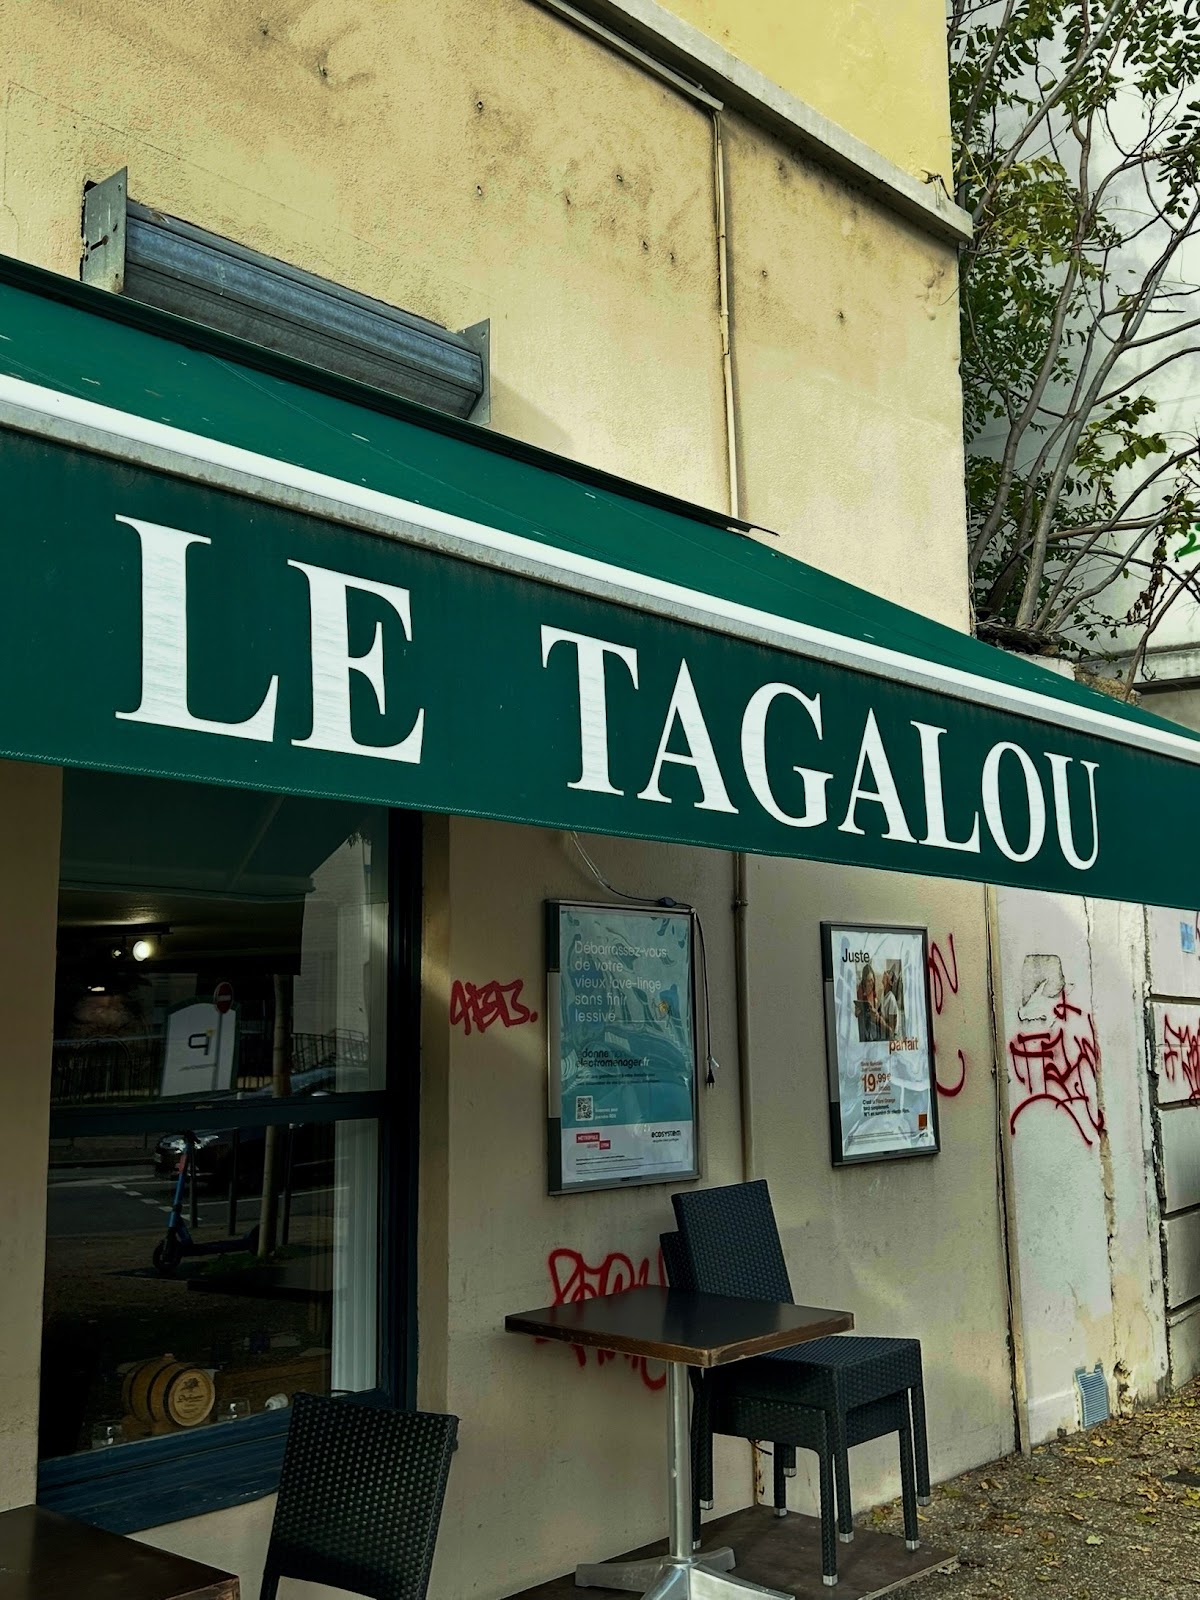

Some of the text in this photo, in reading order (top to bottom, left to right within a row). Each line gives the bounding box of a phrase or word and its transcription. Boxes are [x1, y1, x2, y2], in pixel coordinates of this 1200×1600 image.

[115, 513, 1100, 871] LE TAGALOU
[574, 941, 668, 958] Débarrassez-vous
[842, 948, 870, 963] Juste
[574, 958, 624, 972] de votre
[574, 974, 606, 988] vieux
[574, 992, 628, 1006] sans finir
[575, 1008, 616, 1023] lessivé
[888, 1036, 919, 1055] parfait
